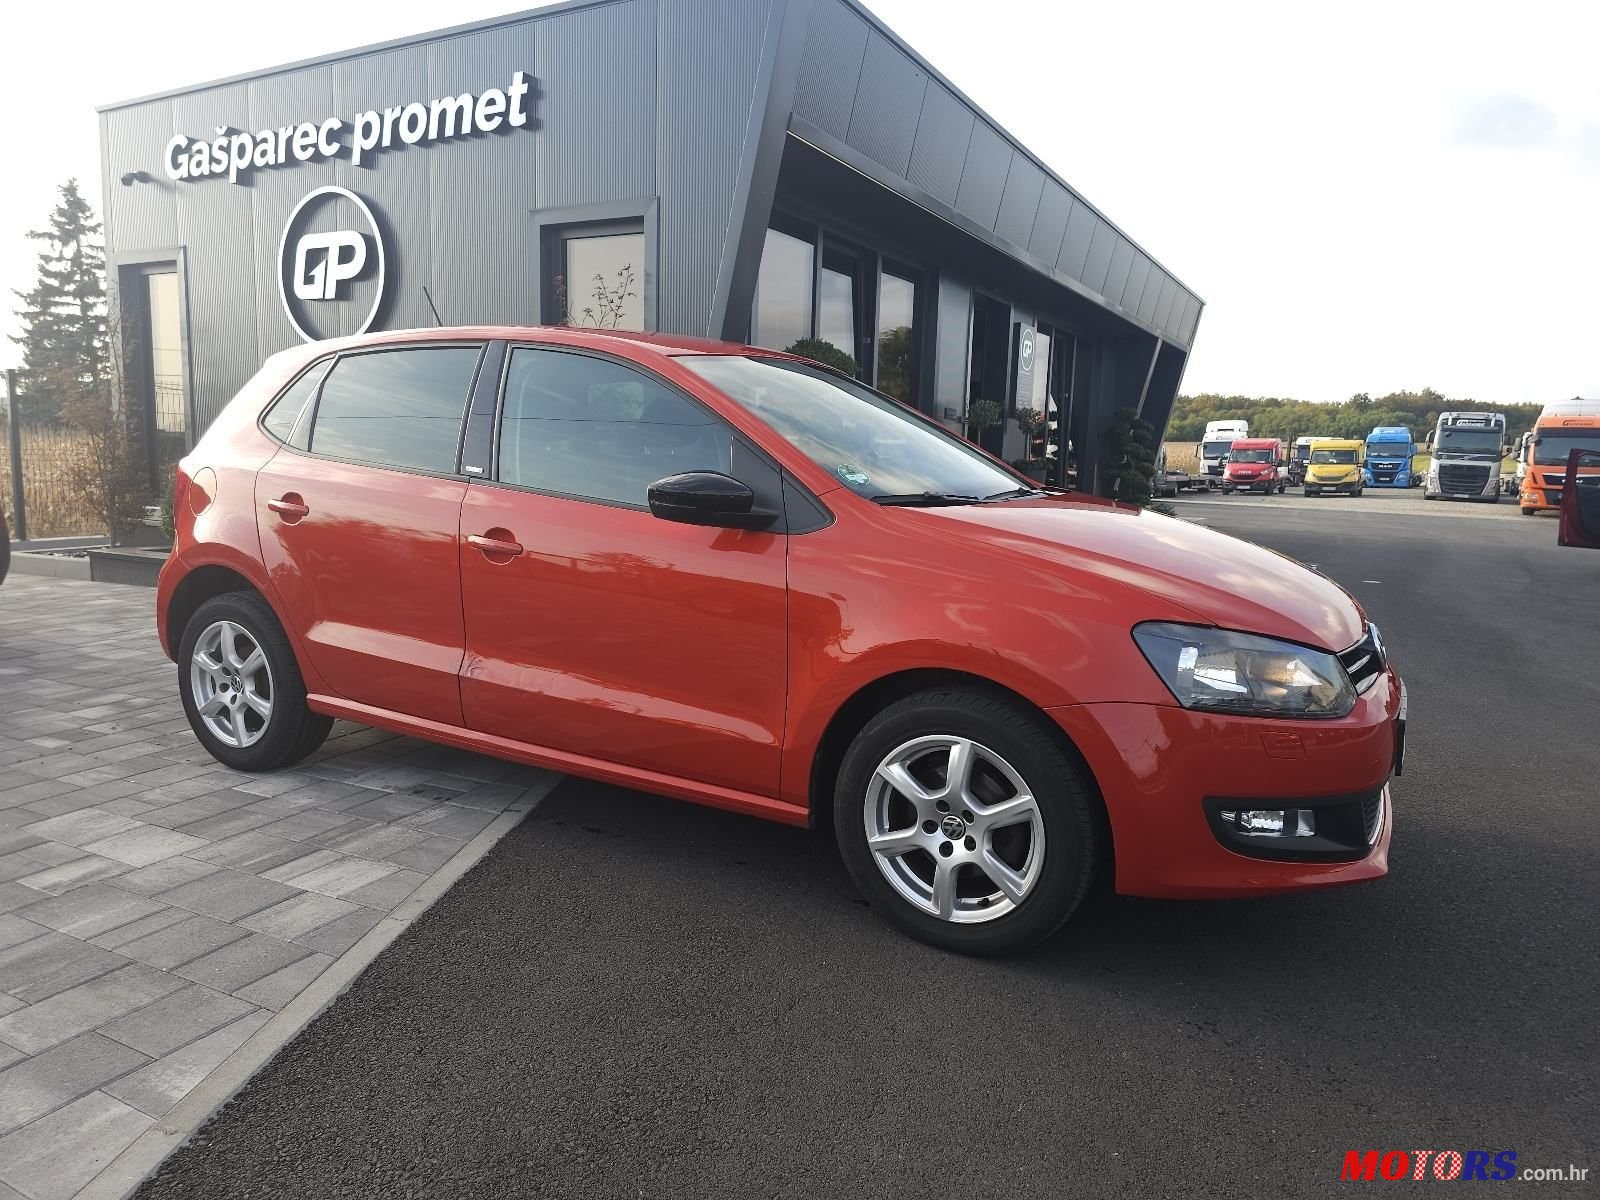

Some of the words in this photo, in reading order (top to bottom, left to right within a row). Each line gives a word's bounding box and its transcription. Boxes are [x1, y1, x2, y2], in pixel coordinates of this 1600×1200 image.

[164, 116, 341, 184] Gašparec
[352, 71, 528, 166] promet
[293, 230, 367, 300] GP
